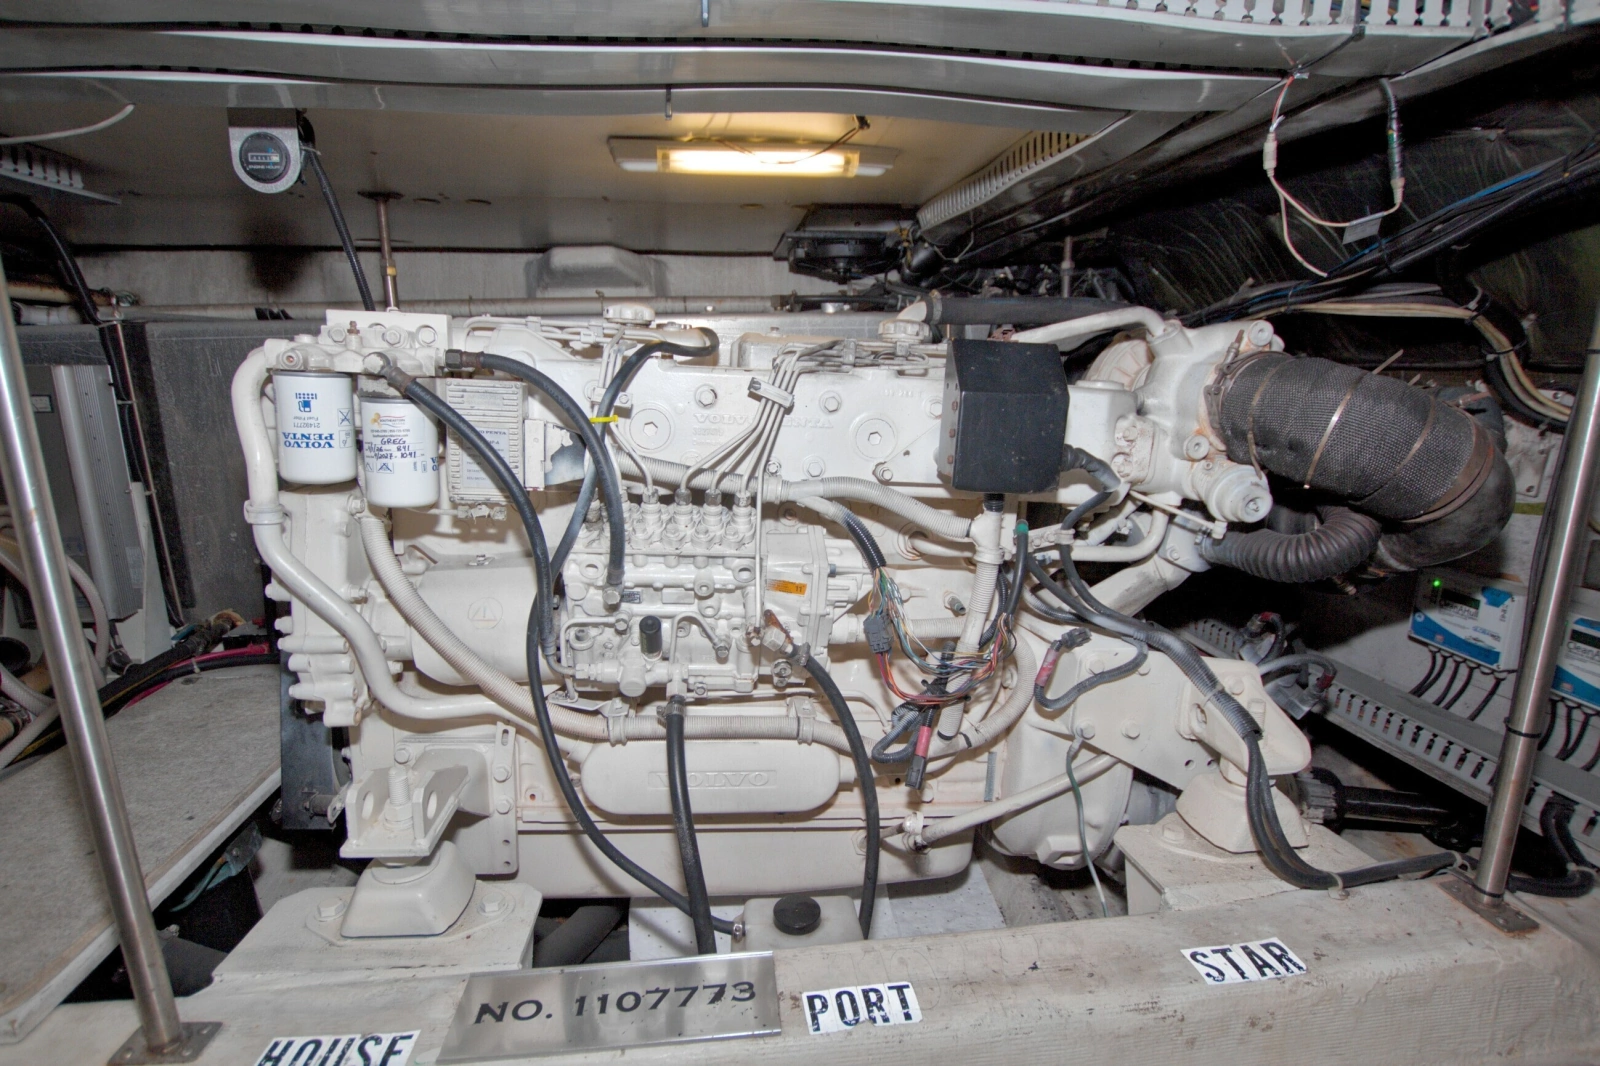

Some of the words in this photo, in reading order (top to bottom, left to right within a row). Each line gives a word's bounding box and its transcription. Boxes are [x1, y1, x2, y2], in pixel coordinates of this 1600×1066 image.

[281, 432, 335, 440] PENTA
[694, 413, 754, 425] VOLV
[781, 417, 834, 429] ENTA
[283, 440, 334, 449] VOLVO
[1189, 941, 1306, 982] STAR
[473, 1000, 553, 1025] NO.
[574, 980, 757, 1017] 1107773
[805, 984, 914, 1032] PORT
[257, 1033, 414, 1066] HOUSE
